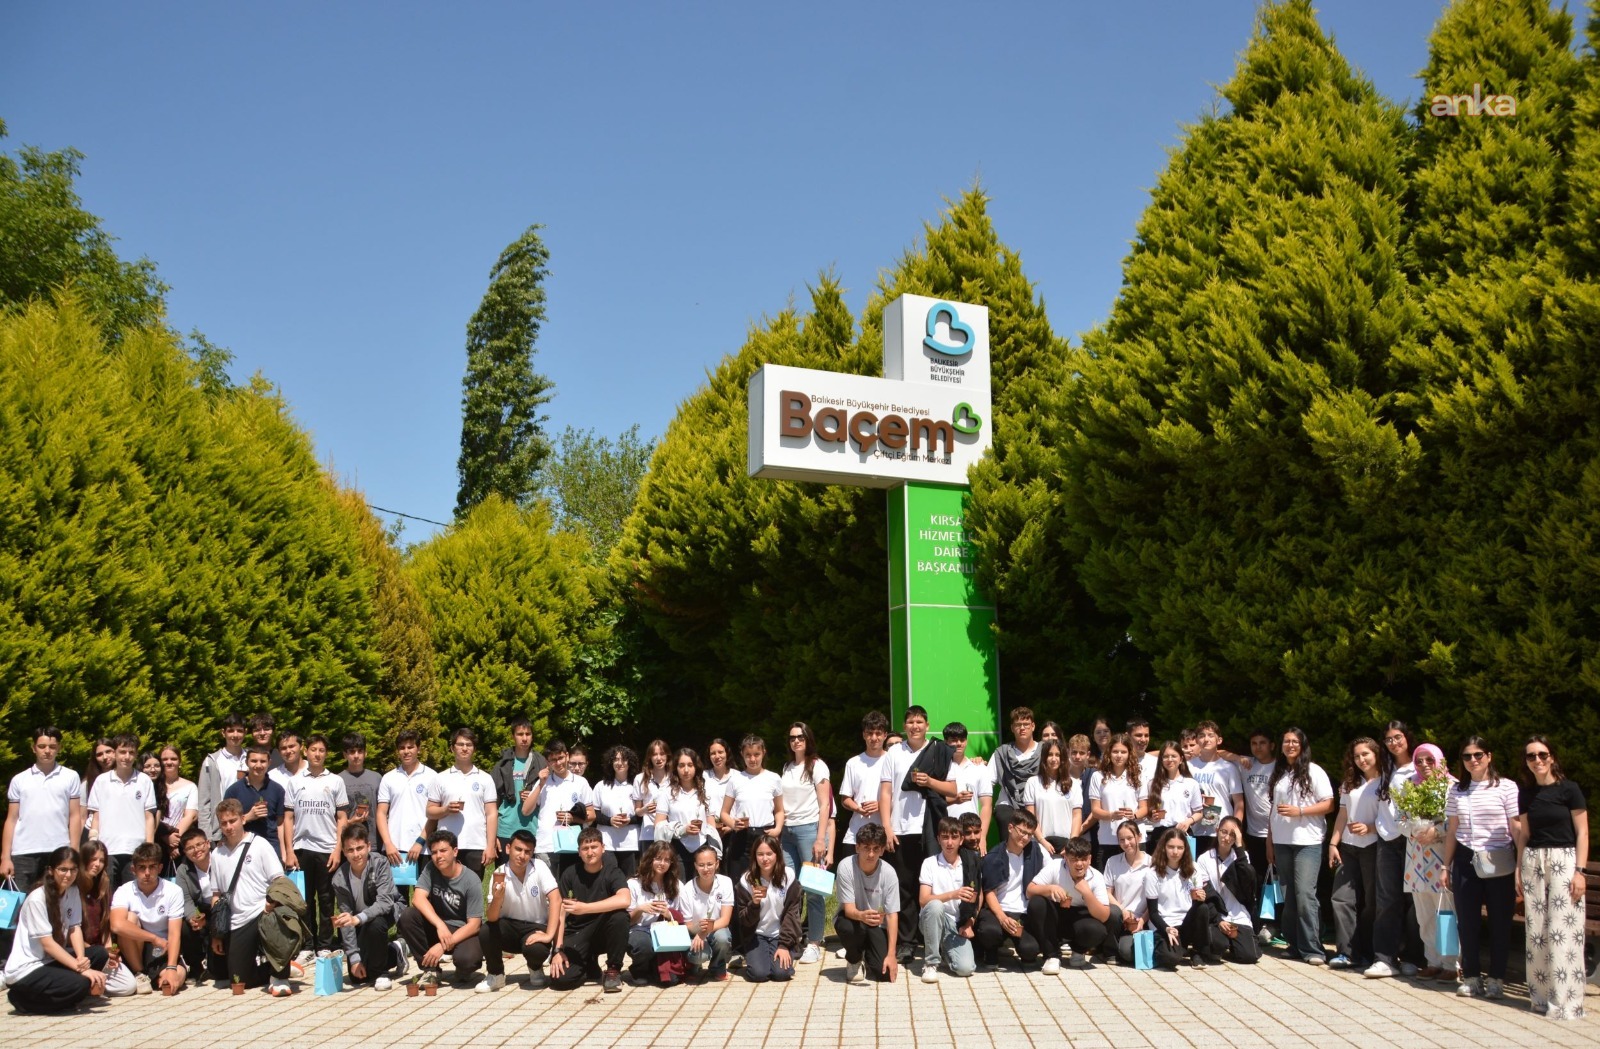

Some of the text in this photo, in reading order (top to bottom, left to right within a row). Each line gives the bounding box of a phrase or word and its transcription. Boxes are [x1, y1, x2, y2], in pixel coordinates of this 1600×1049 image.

[930, 365, 965, 376] BÜYÜKŞEHİR
[930, 374, 961, 384] BELEDİYESİ
[811, 395, 930, 416] Balıkesir Büyükşehir Belediyesi
[780, 390, 954, 453] Baçem
[873, 449, 951, 465] Çiftçi Eğitim Merkezi
[930, 515, 963, 526] KIRSA
[917, 561, 975, 575] BAŞKANLI
[298, 799, 331, 808] Emirates
